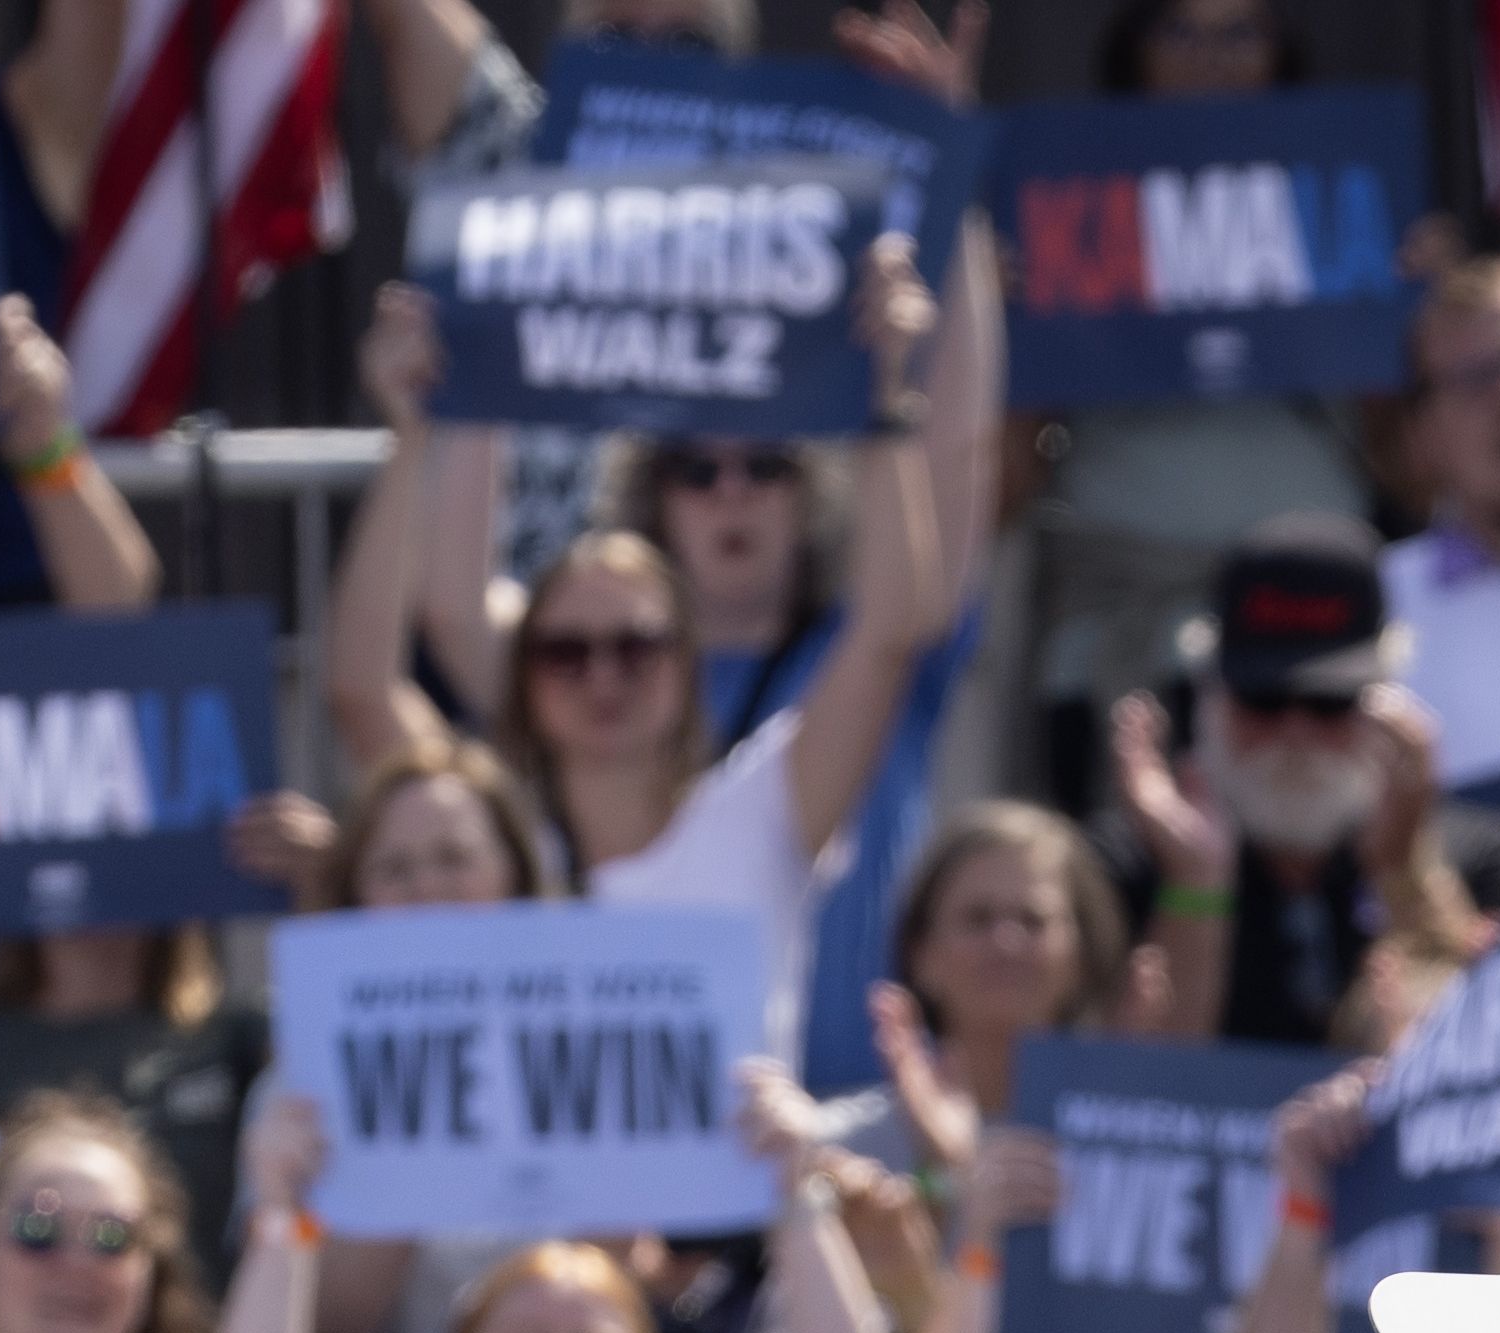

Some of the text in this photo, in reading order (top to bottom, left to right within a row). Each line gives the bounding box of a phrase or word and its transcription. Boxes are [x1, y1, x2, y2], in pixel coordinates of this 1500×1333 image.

[452, 182, 850, 318] HARRIS
[1016, 160, 1396, 318] KAMALA
[515, 308, 785, 400] WALZ
[336, 1016, 725, 1148] WE WIN
[1050, 1152, 1194, 1294] WE
